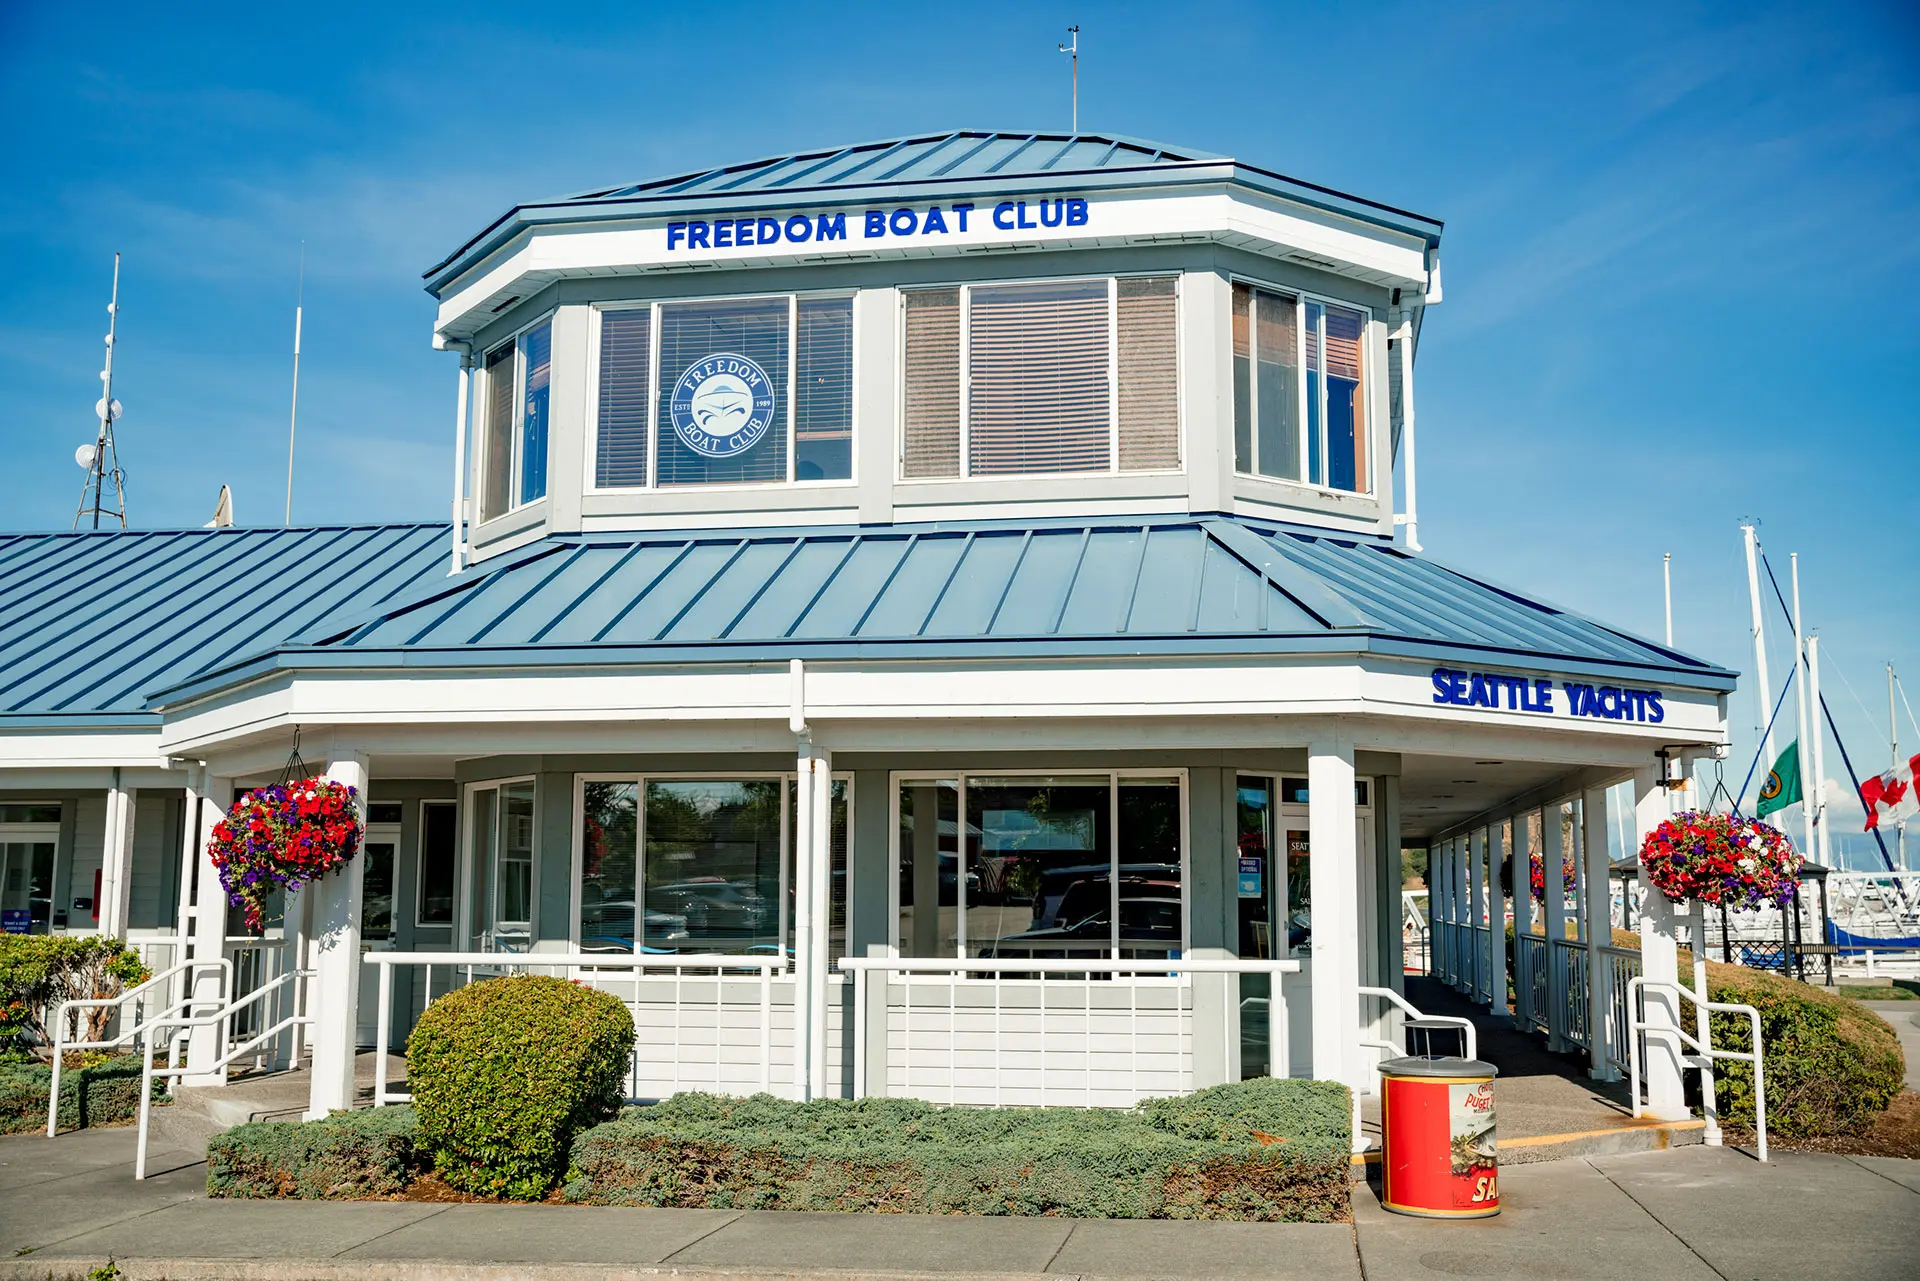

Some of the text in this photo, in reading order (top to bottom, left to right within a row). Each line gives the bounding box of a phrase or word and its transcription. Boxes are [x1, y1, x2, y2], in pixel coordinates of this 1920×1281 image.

[668, 199, 1089, 251] FREEDOM BOAT CLUB
[684, 360, 761, 391] FREEDOM
[684, 417, 763, 451] BOAT CLUB
[1431, 668, 1664, 723] SEATTLE YACHTS
[1291, 842, 1310, 851] SEAT
[1464, 1093, 1490, 1110] PUGET
